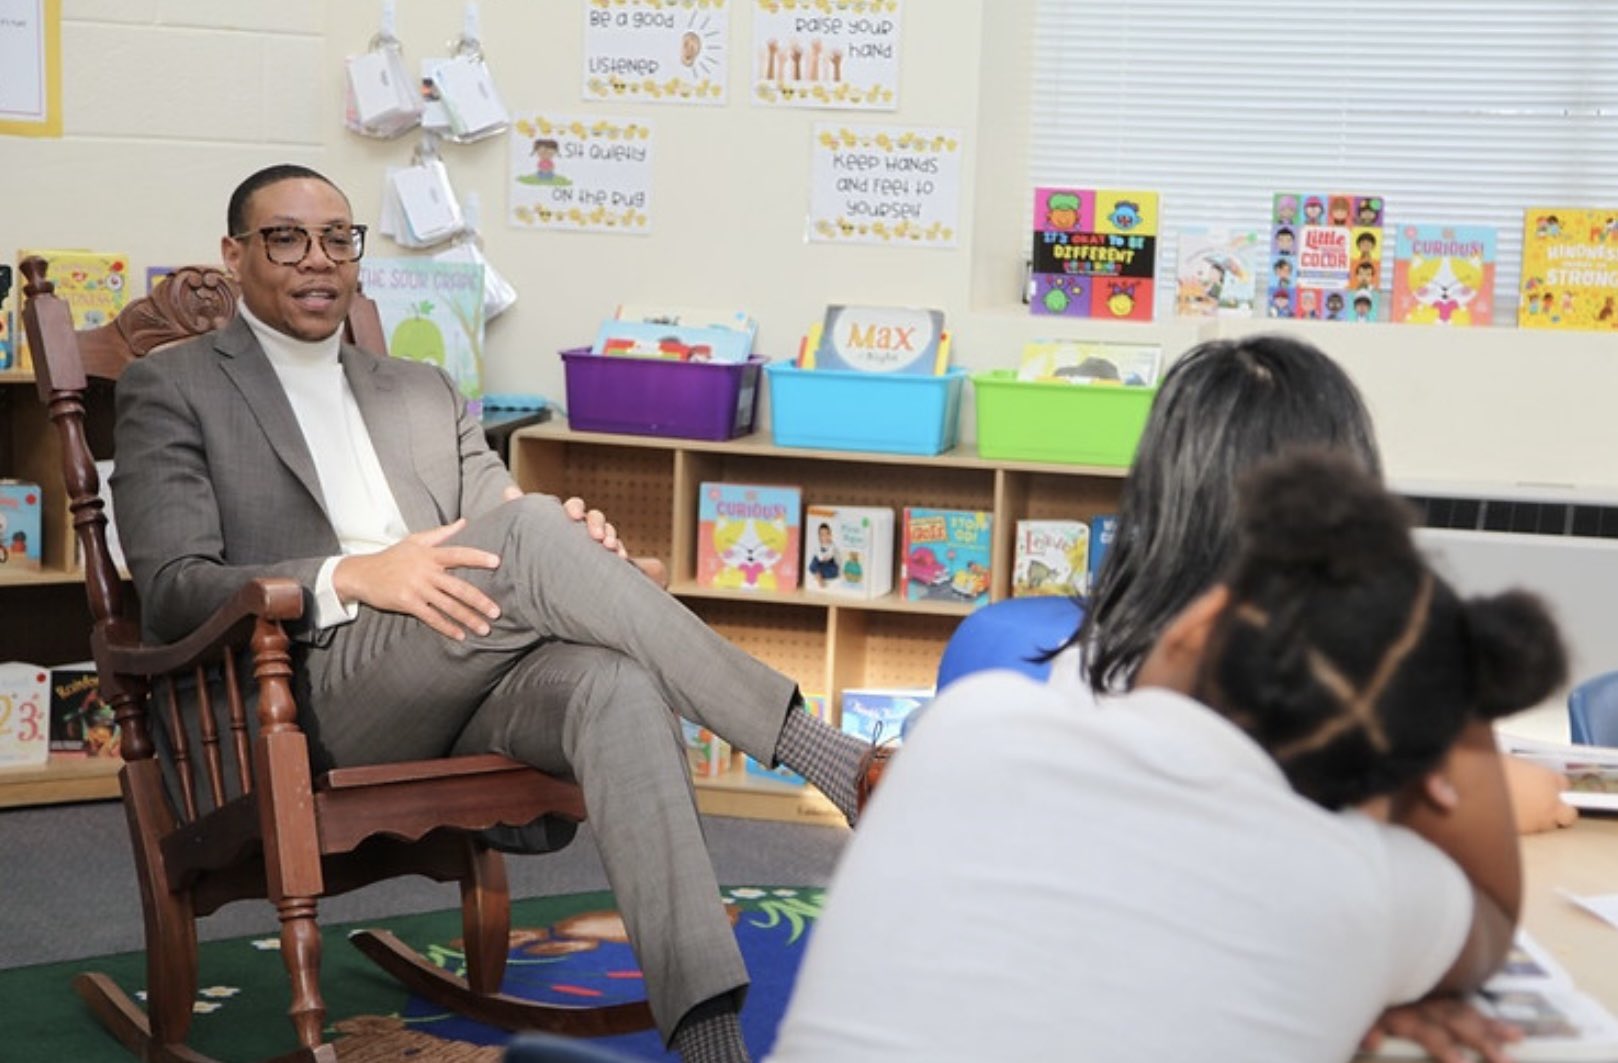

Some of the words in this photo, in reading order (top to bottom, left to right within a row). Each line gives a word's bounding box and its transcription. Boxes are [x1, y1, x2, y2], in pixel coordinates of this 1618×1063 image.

[589, 10, 611, 28] Be
[616, 12, 629, 26] a
[632, 12, 675, 28] good
[847, 19, 893, 35] your
[848, 43, 892, 59] hand
[564, 142, 584, 159] Sit
[833, 153, 880, 171] Keep
[885, 157, 938, 174] Hands
[836, 178, 868, 193] and
[915, 180, 934, 195] to
[551, 188, 574, 203] on
[578, 189, 608, 206] the
[846, 200, 922, 219] yourself
[1306, 230, 1346, 250] Little
[1052, 245, 1135, 264] DIFFERENT
[1546, 243, 1618, 261] KINDNES
[847, 322, 915, 351] Max
